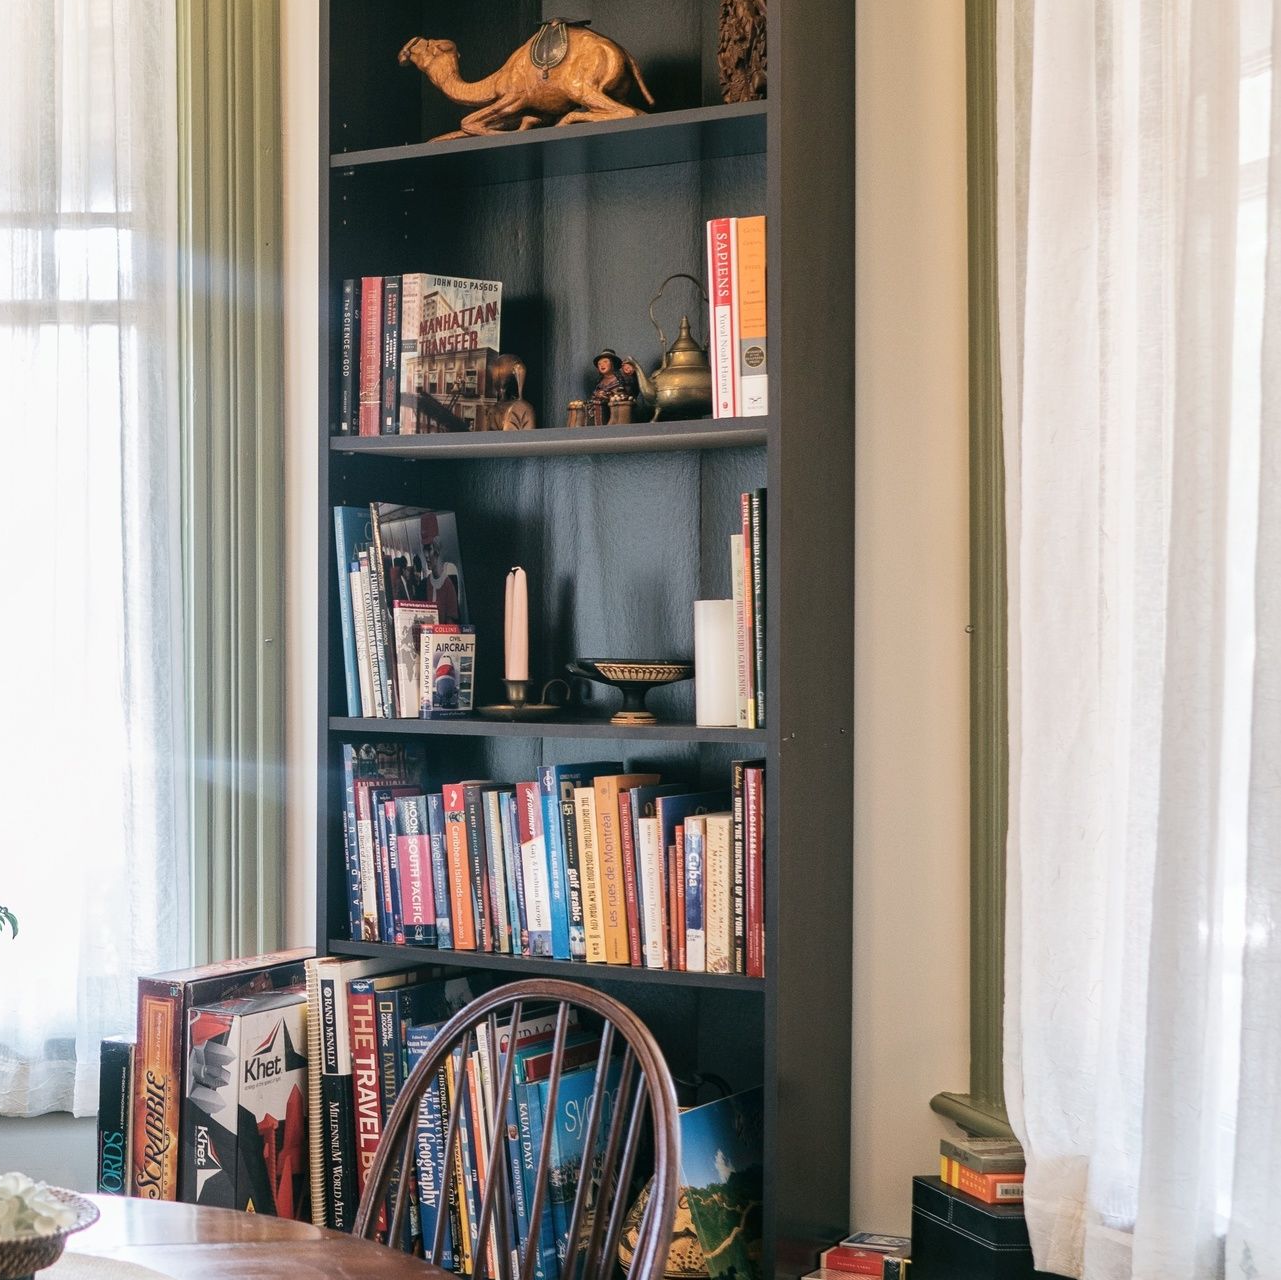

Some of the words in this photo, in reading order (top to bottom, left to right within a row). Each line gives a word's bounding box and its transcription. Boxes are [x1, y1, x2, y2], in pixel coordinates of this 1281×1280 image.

[716, 233, 729, 297] SAPIENS
[433, 277, 451, 287] JOHN
[453, 280, 468, 289] DOS
[469, 281, 499, 292] PASSOS
[343, 312, 352, 350] SCIENCE
[419, 301, 499, 337] MANHATTAN
[719, 313, 728, 338] Yuval
[419, 330, 478, 355] TRANSFER
[720, 340, 728, 363] Noah
[342, 359, 350, 377] GOD
[721, 365, 729, 394] Harari
[752, 498, 761, 556] HUMMINGBIRD
[754, 557, 762, 594] GARDENS
[736, 600, 746, 653] HUMMINGBIRD
[435, 643, 475, 652] AIRCRAFT
[738, 654, 747, 697] GARDENING
[409, 801, 419, 833] MOON
[389, 833, 397, 869] Havana
[600, 812, 615, 864] Montréal
[408, 838, 420, 877] SOUTH
[606, 866, 617, 881] de
[688, 852, 699, 887] Cuba
[567, 868, 580, 887] gulf
[735, 885, 742, 895] OF
[411, 881, 422, 923] PACIFIC
[570, 890, 582, 922] arabic
[609, 908, 618, 928] Les
[324, 998, 334, 1025] RAND
[353, 999, 374, 1050] THE
[244, 1056, 283, 1083] Khet
[384, 1051, 396, 1100] FAMILY
[355, 1053, 378, 1148] TRAVEL
[417, 1088, 437, 1127] World
[136, 1070, 168, 1200] SCRABBLE
[329, 1102, 341, 1162] MILLENNIUM
[519, 1103, 531, 1141] KAUA'I
[197, 1125, 207, 1166] Khet
[521, 1143, 533, 1169] DAYS
[332, 1166, 343, 1199] WORLD
[416, 1132, 439, 1208] Geography
[513, 1159, 524, 1217] GRANDANGOLO
[334, 1200, 344, 1227] ATLAS
